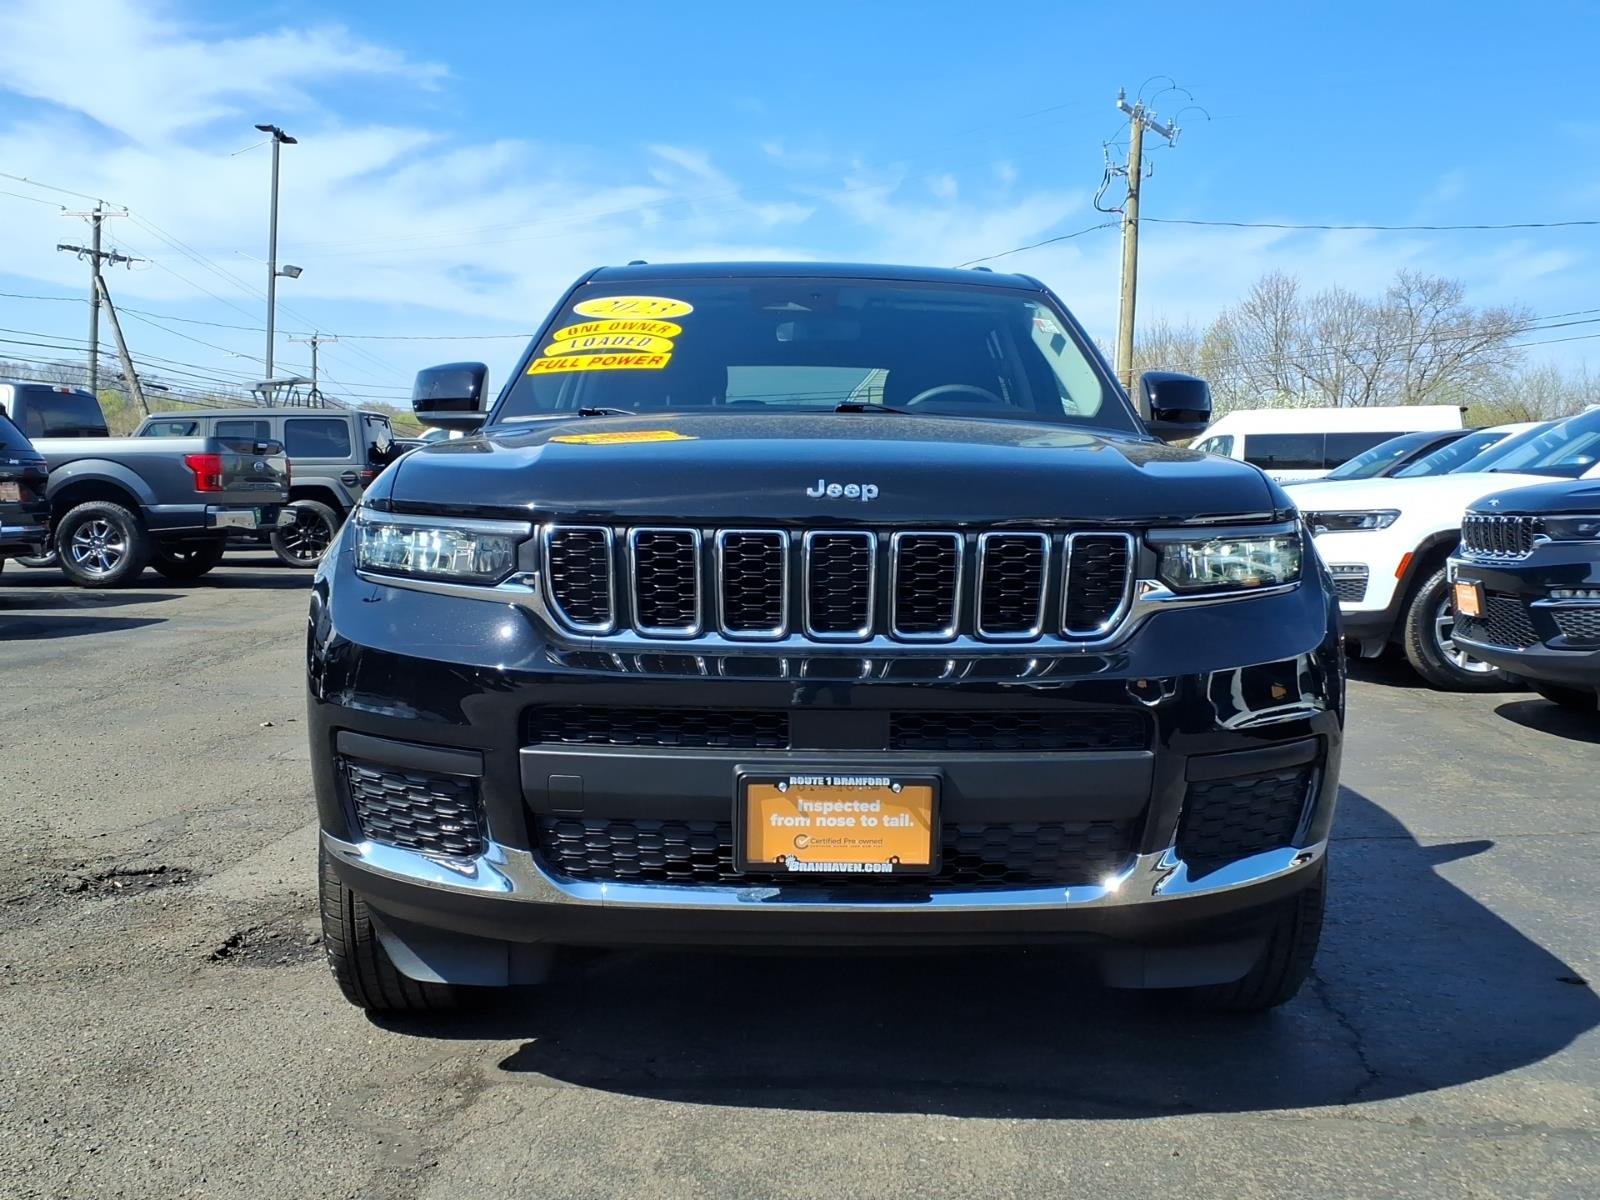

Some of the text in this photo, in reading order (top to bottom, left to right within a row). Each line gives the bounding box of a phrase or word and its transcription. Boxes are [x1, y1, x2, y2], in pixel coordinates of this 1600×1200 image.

[567, 321, 672, 337] ONE OWNER
[571, 336, 652, 348] LOADED
[533, 355, 664, 371] FULL POWER
[806, 479, 879, 502] Jeep
[790, 776, 891, 786] ROUTE 1 BRANFORD
[798, 799, 881, 815] Inspected
[770, 813, 914, 827] from nose to tail.
[810, 837, 842, 845] Certified
